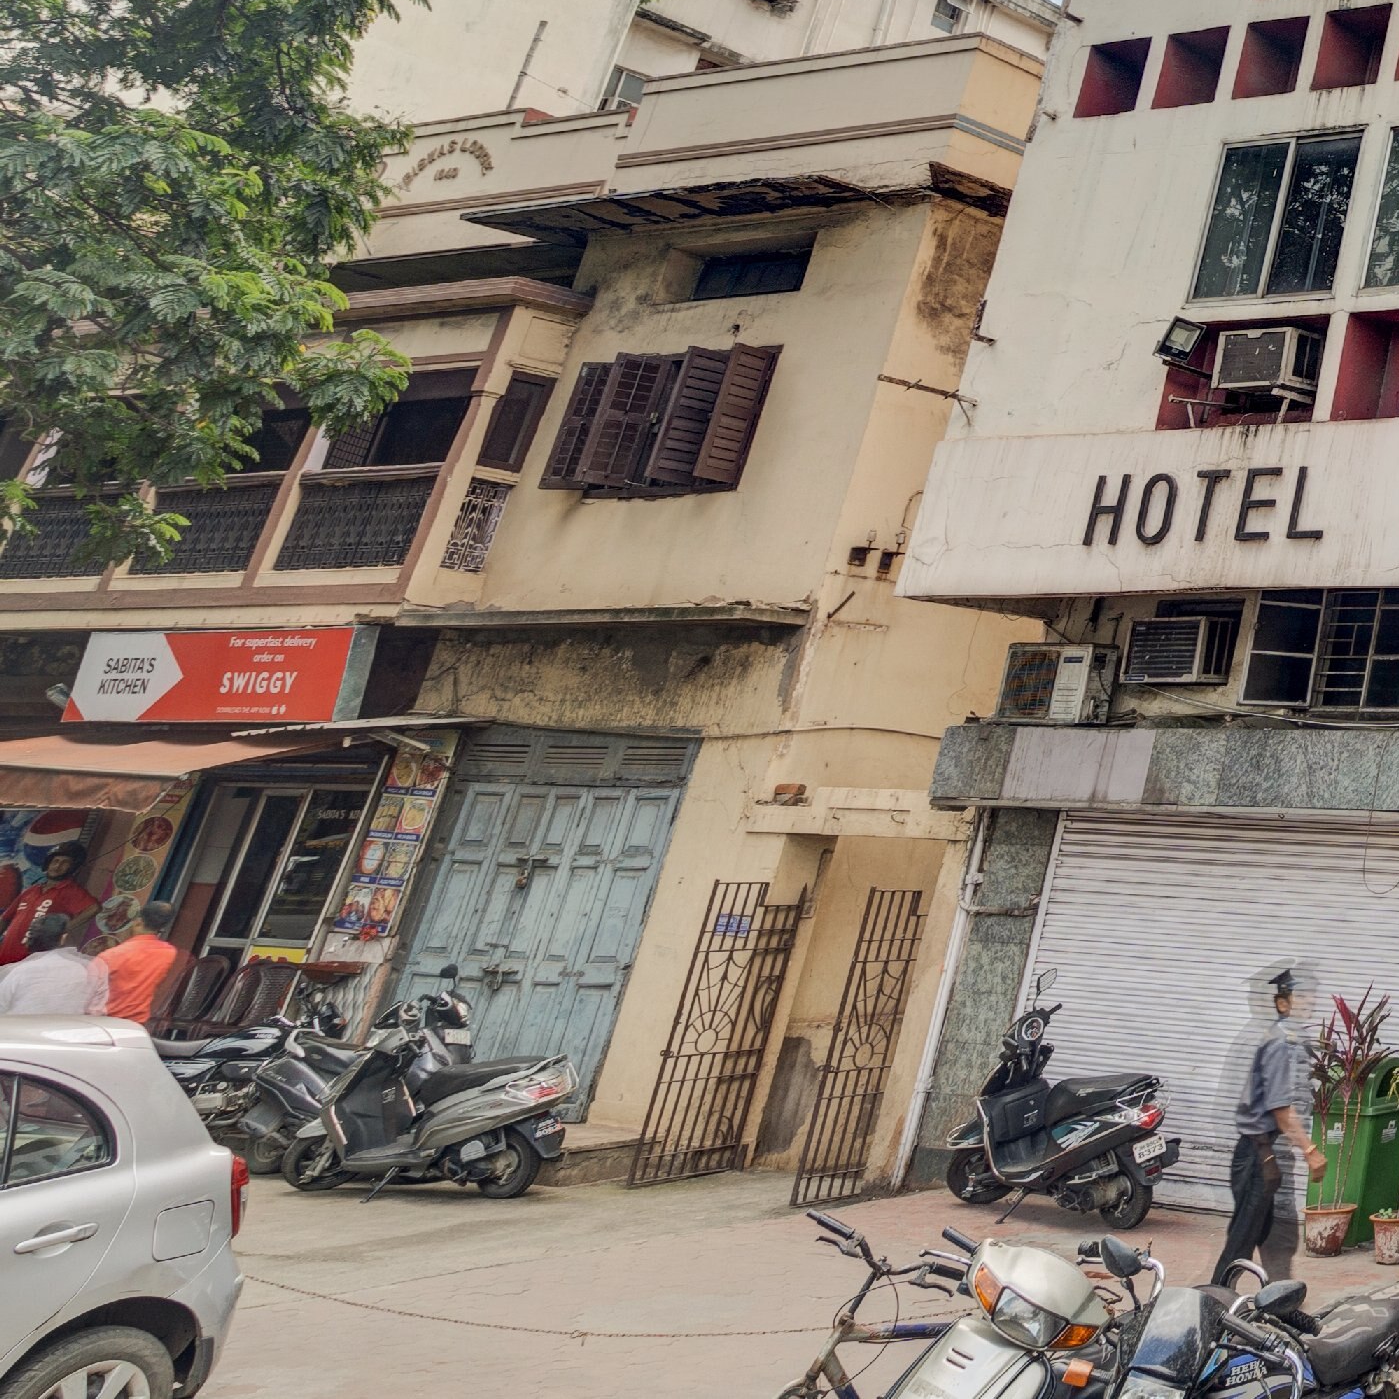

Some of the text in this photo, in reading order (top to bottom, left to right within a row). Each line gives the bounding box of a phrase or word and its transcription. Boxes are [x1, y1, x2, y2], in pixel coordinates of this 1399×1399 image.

[1081, 465, 1325, 547] HOTEL
[229, 636, 318, 649] For superfast delivery
[103, 657, 157, 674] SABITA'S
[252, 652, 285, 663] order on
[97, 678, 150, 695] KITCHEN
[219, 671, 298, 694] SWIGGY
